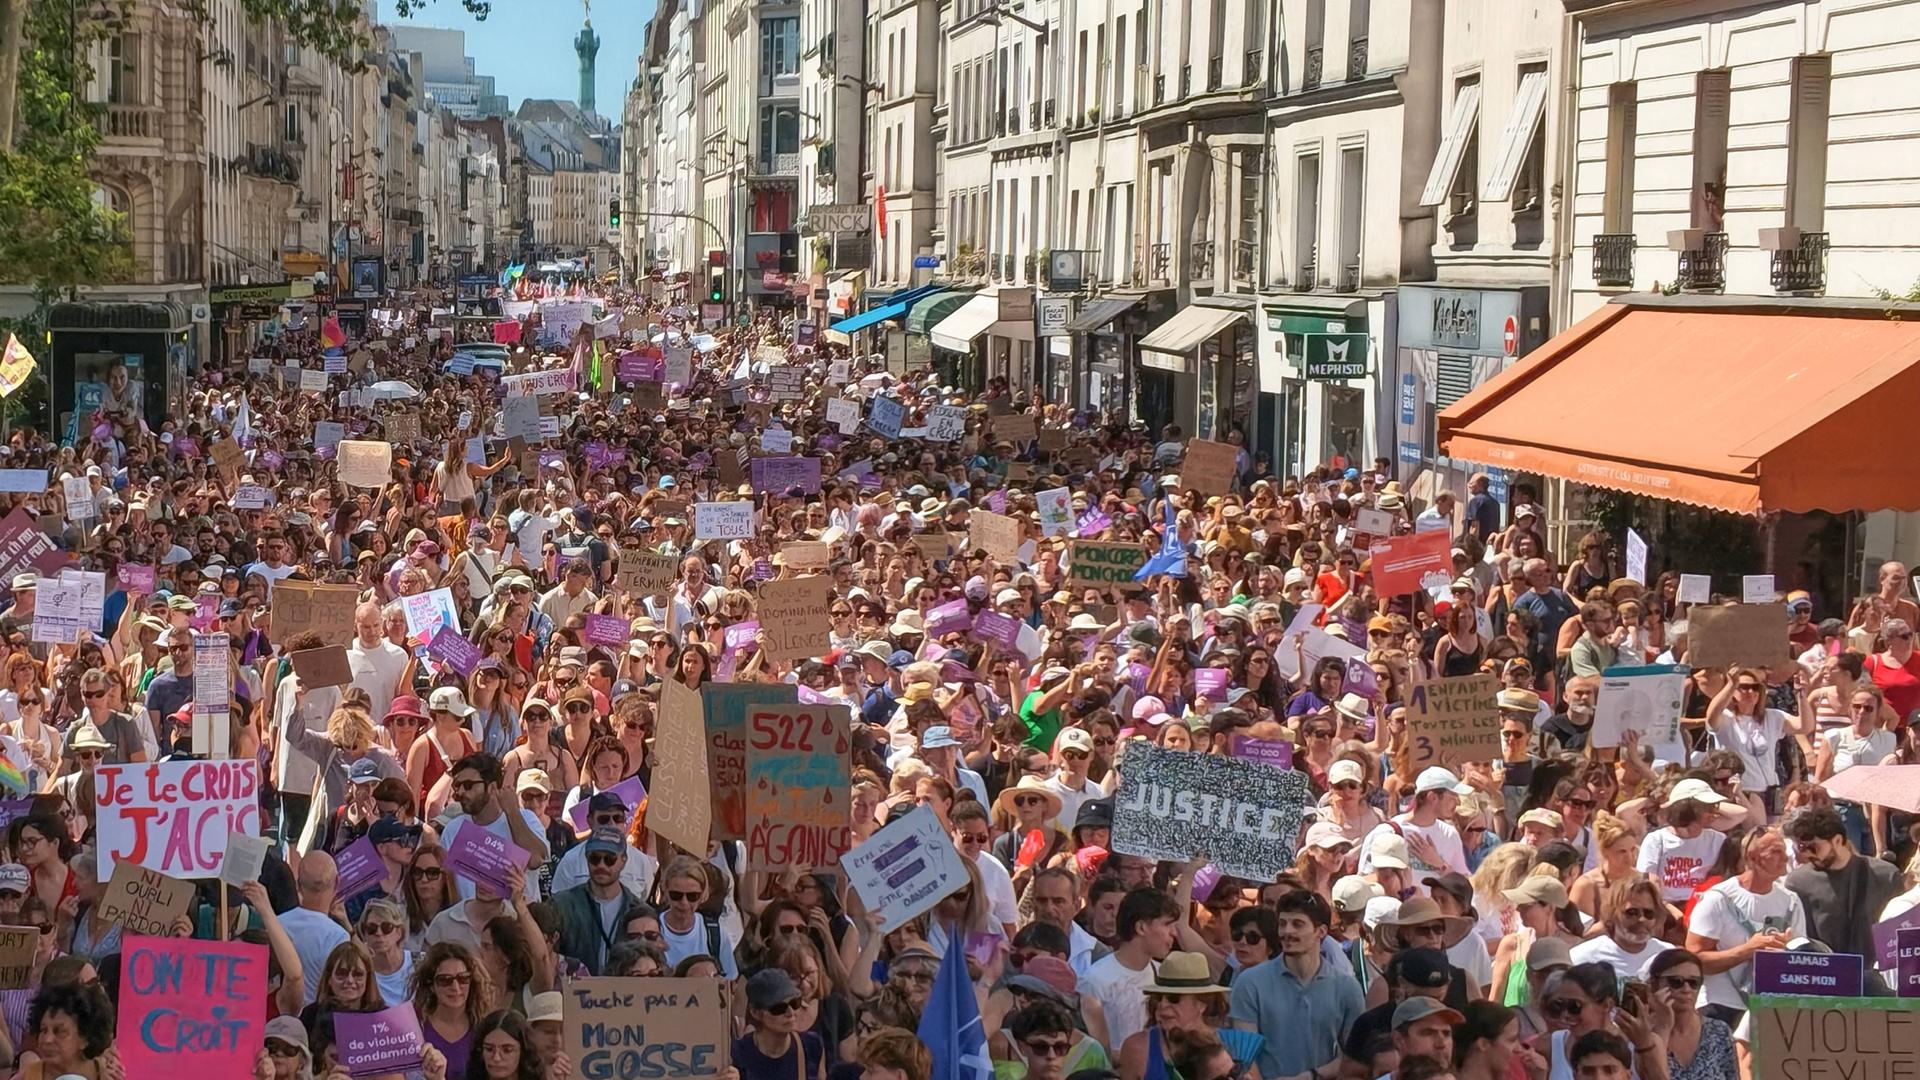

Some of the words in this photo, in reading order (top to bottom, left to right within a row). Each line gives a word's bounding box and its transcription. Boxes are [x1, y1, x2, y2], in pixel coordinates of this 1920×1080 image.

[811, 214, 865, 231] RINCK
[1309, 364, 1365, 375] MEPHISTO
[1410, 685, 1428, 714] 1
[1428, 680, 1490, 697] ENFANT
[751, 712, 814, 752] 522
[1411, 720, 1465, 732] TOUTES
[1473, 716, 1497, 729] LES
[1416, 736, 1434, 762] 3
[97, 768, 132, 807] Je
[145, 765, 178, 803] te
[1124, 781, 1287, 839] JUSTICE
[1666, 856, 1703, 869] WORLD
[141, 867, 162, 889] NI
[131, 899, 155, 916] NI
[104, 905, 174, 939] PARDON
[1787, 955, 1830, 967] JAMAIS
[129, 948, 184, 997] ON
[193, 952, 255, 1000] TE
[1779, 973, 1810, 985] SANS
[1811, 975, 1836, 987] MON
[573, 989, 634, 1010] Touche
[371, 1021, 390, 1035] 1%
[581, 1042, 717, 1080] GOSSE
